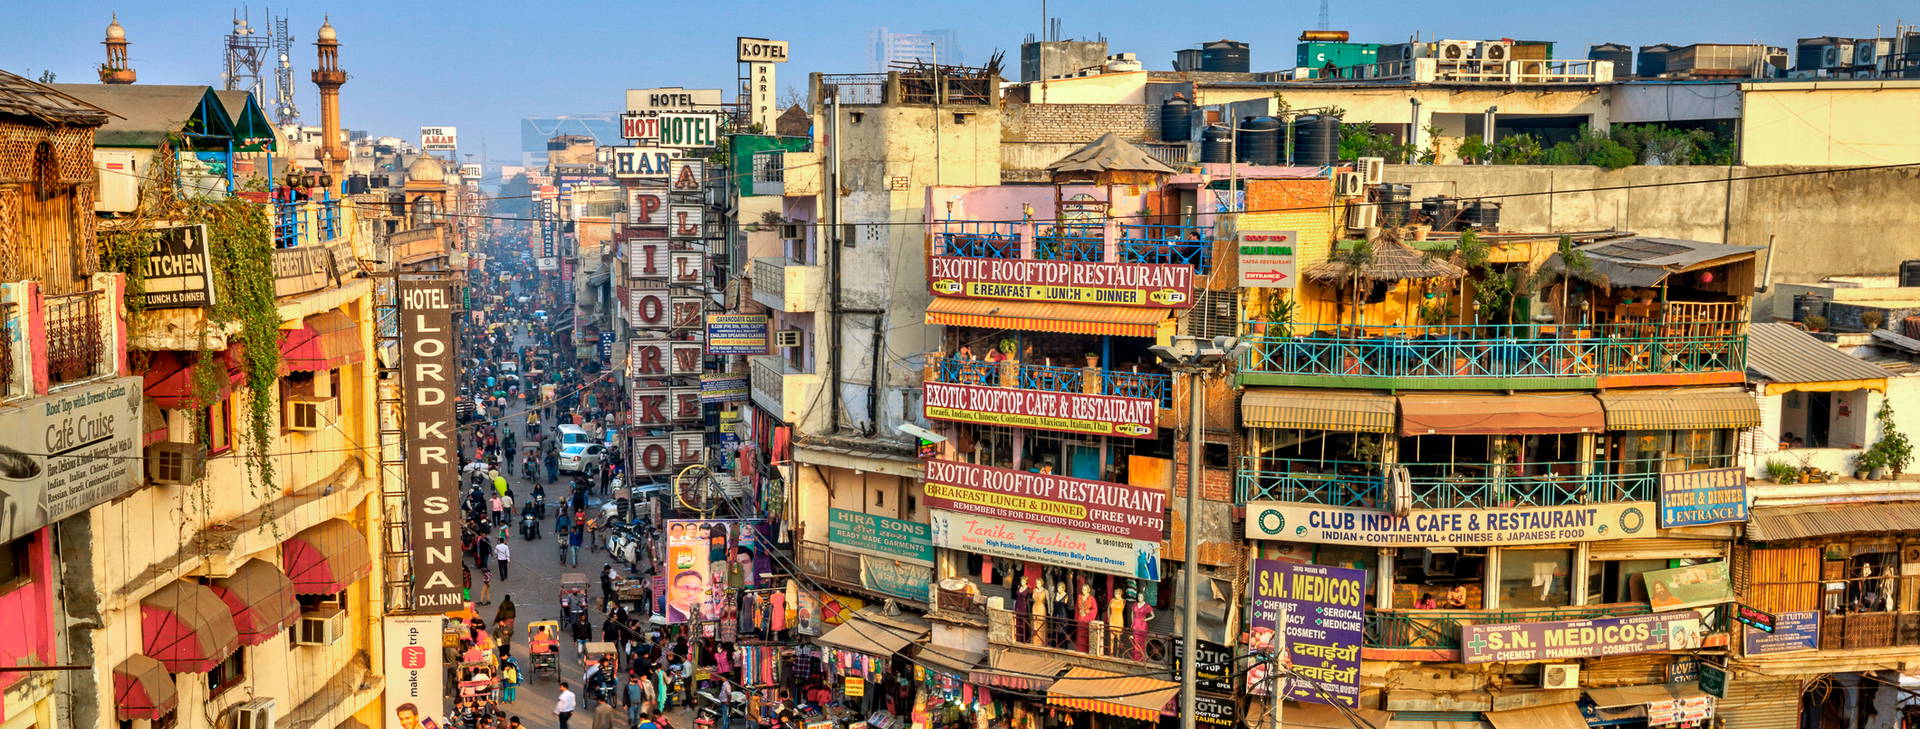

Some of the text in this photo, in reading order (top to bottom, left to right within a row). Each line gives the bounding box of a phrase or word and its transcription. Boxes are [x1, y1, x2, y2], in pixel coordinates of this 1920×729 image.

[743, 44, 786, 58] HOTEL
[650, 94, 695, 106] HOTEL
[660, 116, 714, 145] HOTEL
[1240, 246, 1292, 255] CLUB INDIA
[932, 258, 1188, 288] EXOTIC ROOFTOP RESTAURANT
[148, 292, 205, 304] LUNCH & DINNER
[404, 288, 449, 310] HOTEL
[1046, 286, 1081, 300] LUNCH
[1096, 289, 1137, 302] DINNER
[46, 384, 126, 416] Roof Top with Everest Garden
[926, 385, 1152, 424] EXOTIC ROOFTOP CAFE & RESTAURANT
[952, 410, 972, 420] Indian,
[46, 412, 114, 453] Café Cruise
[414, 314, 454, 590] LORD KRISHNA
[927, 461, 1166, 514] EXOTIC ROOFTOP RESTAURANT
[1664, 470, 1742, 491] BREAKFAST
[928, 484, 1084, 517] BREAKFAST LUNCH & DINNER
[1665, 488, 1742, 508] LUNCH & DINNER
[838, 512, 876, 526] HIRA
[881, 520, 924, 536] SONS
[953, 501, 1130, 535] REMEMBER US FOR DELICIOUS FOOD SERVICES
[1089, 508, 1164, 532] (FREE WI-FI)
[1309, 510, 1355, 530] CLUB
[1362, 514, 1410, 532] INDIA
[1416, 514, 1462, 532] CAFE
[1468, 513, 1480, 532] &
[1487, 508, 1597, 532] RESTAURANT
[1676, 506, 1734, 522] ENTRANCE
[837, 530, 860, 540] READY
[862, 534, 882, 544] MADE
[884, 539, 925, 552] GARMENTS
[964, 520, 1087, 552] Tanika Fashion
[1322, 529, 1584, 544] INDIAN CONTINENTAL CHINESE & JAPANESE FOOD
[986, 539, 1125, 566] High Fashion Sequins Garments Belly Dance Dresses
[1260, 570, 1360, 607] S.N. MEDICOS
[1323, 618, 1360, 632] MEDICINE
[1324, 607, 1362, 620] SERGICAL
[1286, 626, 1326, 640] COSMETIC
[1488, 623, 1650, 650] S.N. MEDICOS
[1497, 650, 1536, 660] CHEMIST
[1546, 647, 1593, 658] PHARMACY
[1602, 643, 1643, 654] COSMETIC
